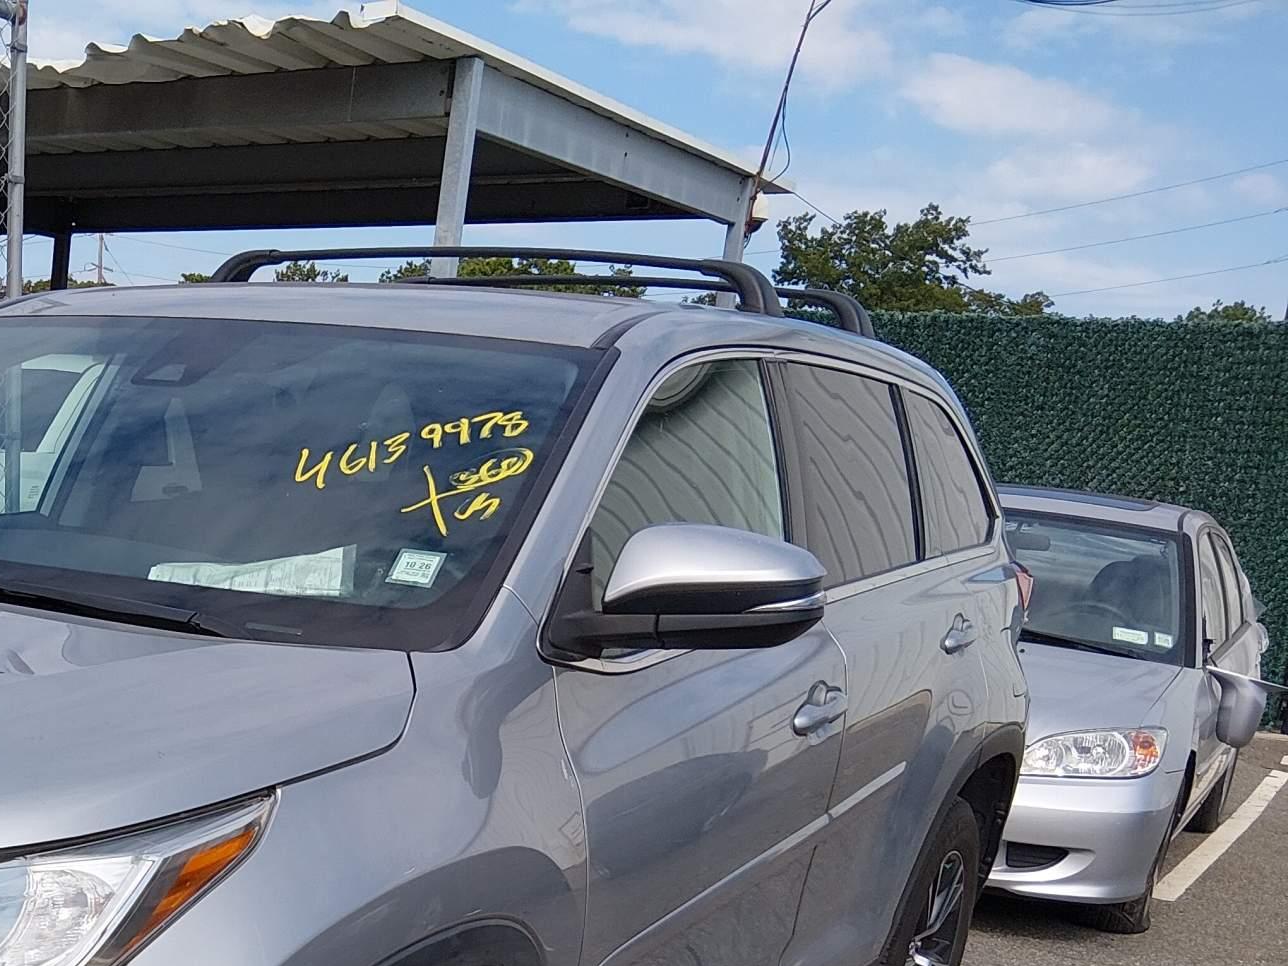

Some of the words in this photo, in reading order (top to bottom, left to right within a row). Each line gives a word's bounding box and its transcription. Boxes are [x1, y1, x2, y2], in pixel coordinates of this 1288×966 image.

[294, 431, 411, 489] 4613
[420, 411, 529, 449] 9978
[418, 562, 432, 570] 26
